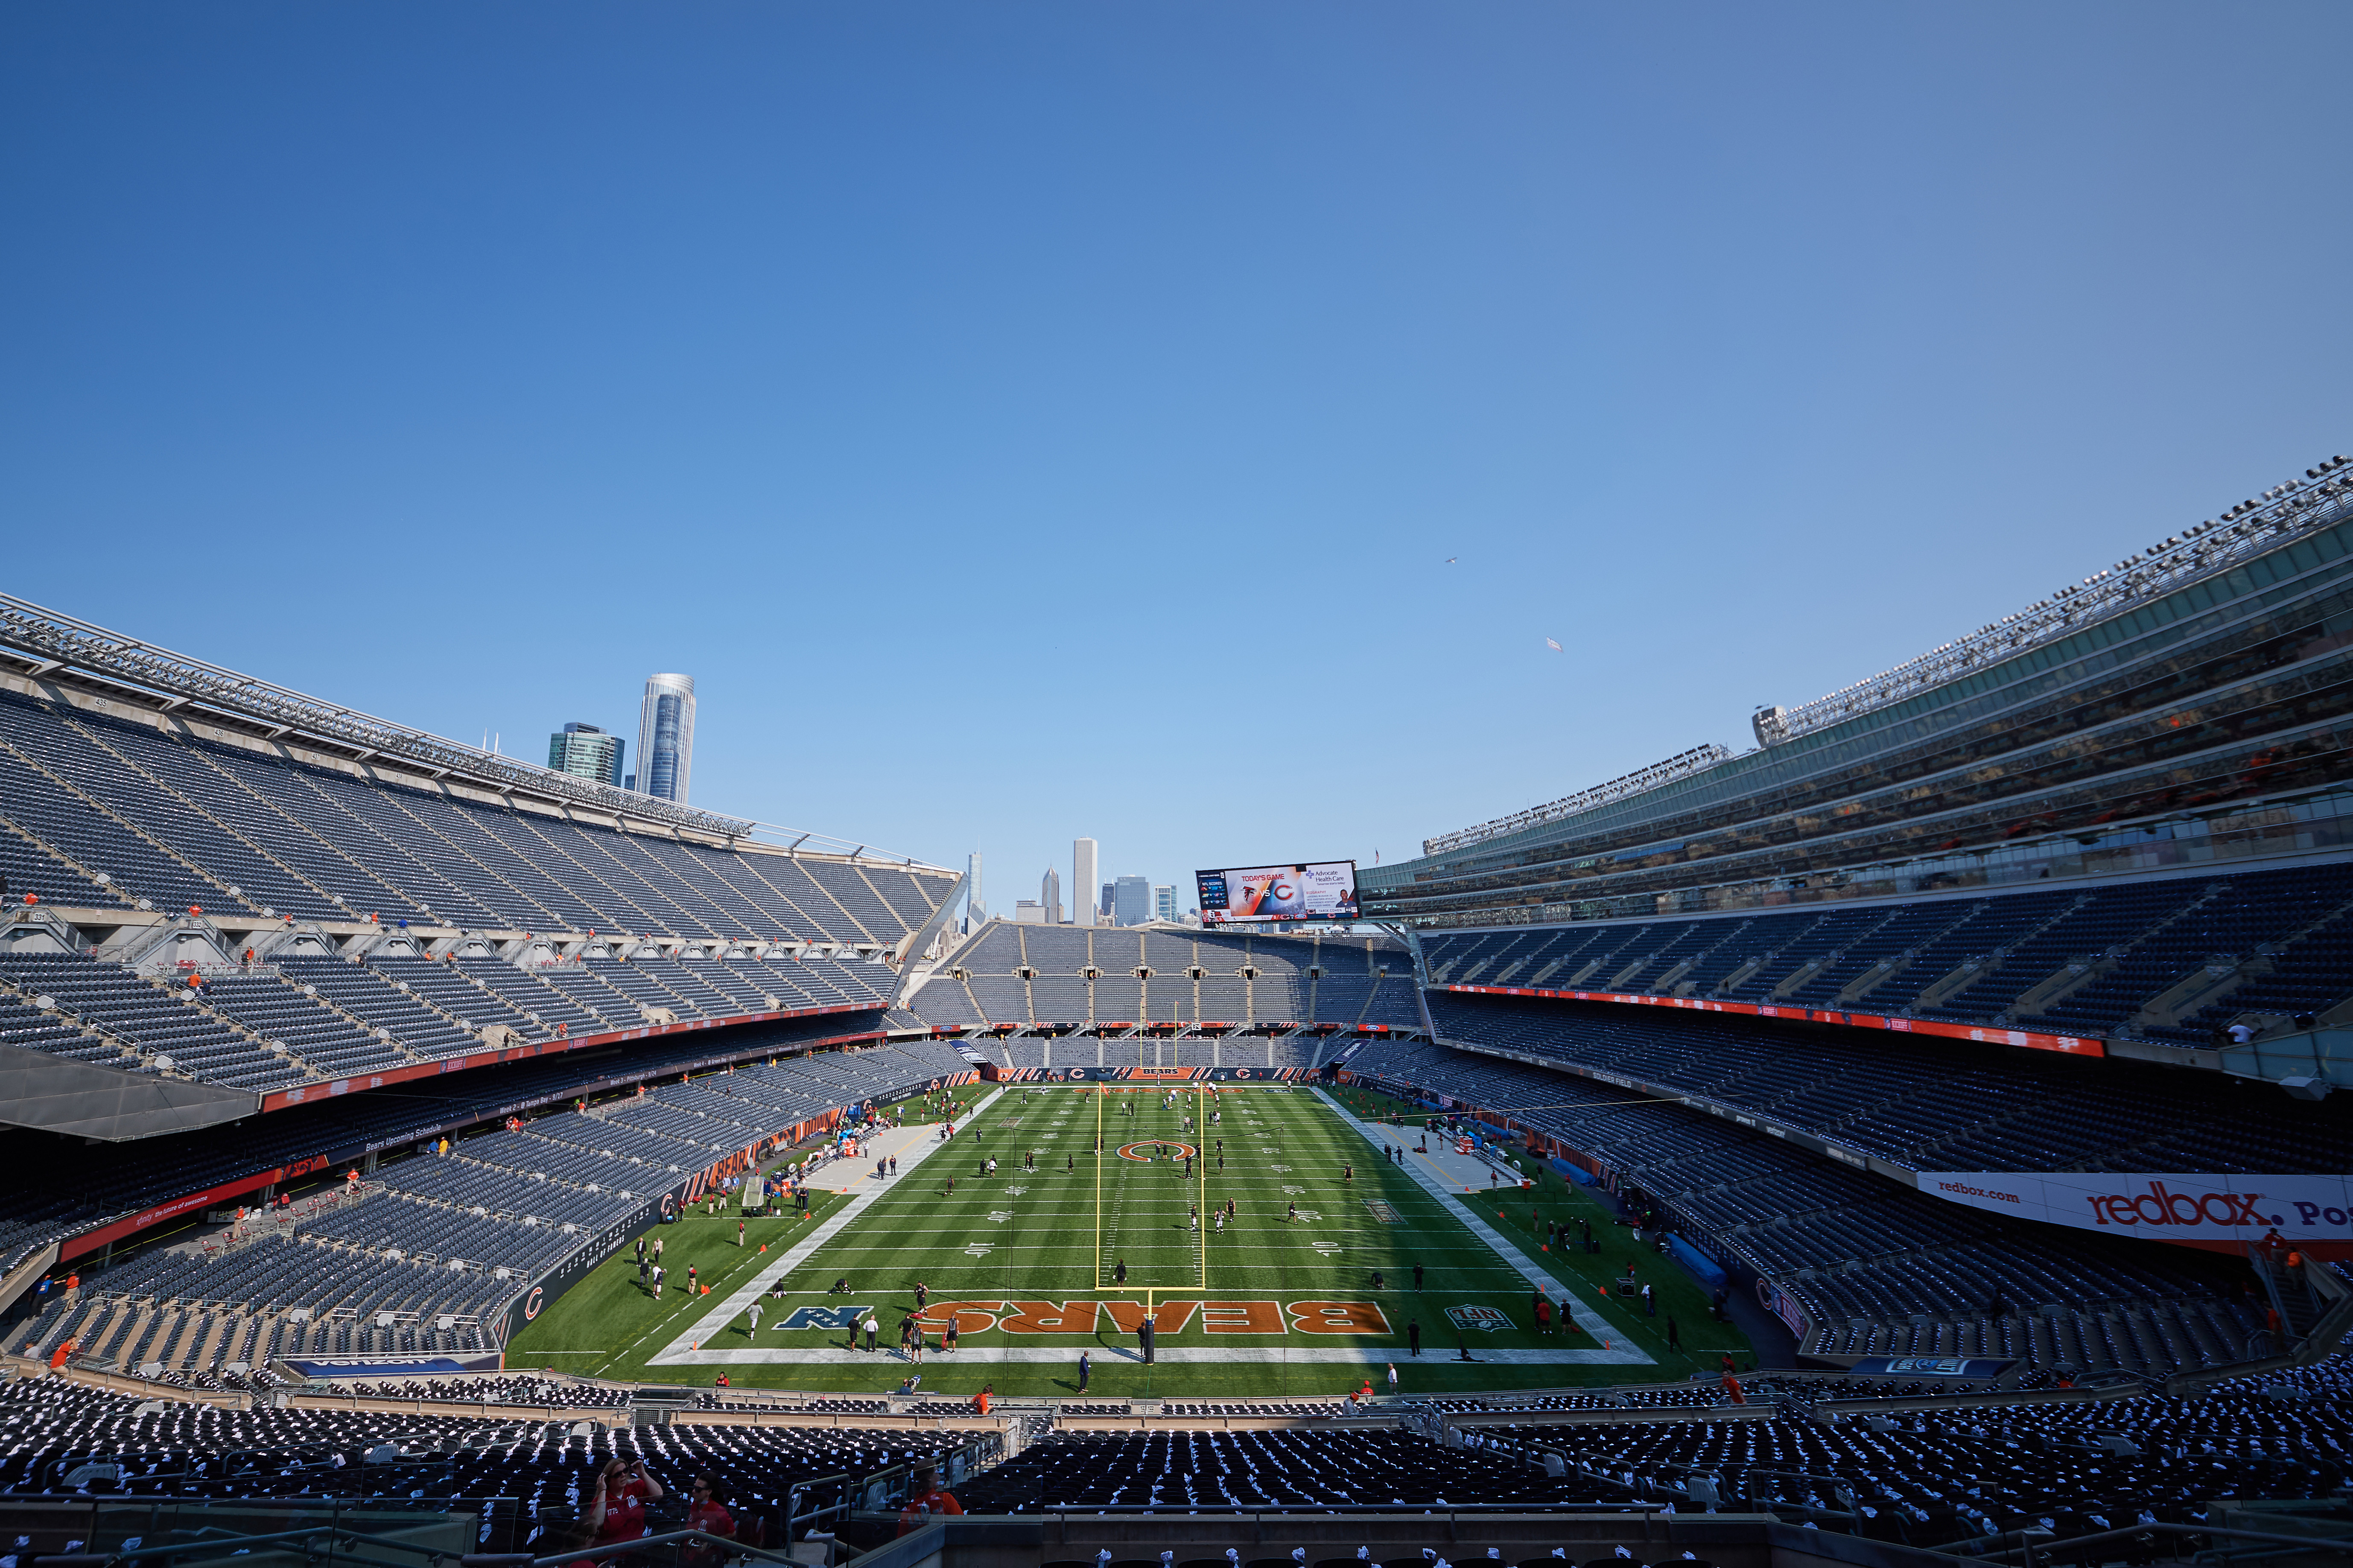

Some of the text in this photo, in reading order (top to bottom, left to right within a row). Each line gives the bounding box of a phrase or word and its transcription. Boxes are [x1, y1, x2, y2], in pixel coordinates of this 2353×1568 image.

[95, 698, 107, 707] 435
[215, 729, 223, 737] 436
[1891, 1019, 1908, 1029] KICKOFF
[447, 1060, 463, 1070] KICKOFF
[627, 1073, 645, 1081] Pittsburgh
[1593, 1072, 1631, 1088] SOLDIER FIELD
[500, 1105, 511, 1114] Week
[552, 1092, 563, 1100] 9/17
[366, 1124, 441, 1151] Bears Upcoming Schedule
[1766, 1125, 1784, 1138] verizon
[1282, 1186, 1306, 1195] 30
[1939, 1182, 2020, 1204] redbox.com
[136, 1213, 153, 1226] xfinity
[163, 1205, 177, 1214] future
[184, 1196, 207, 1207] awesome
[661, 1193, 673, 1214] C
[2087, 1181, 2272, 1226] redbox
[1293, 1211, 1322, 1223] 20
[587, 1235, 624, 1268] HALL OF FAMERS
[964, 1242, 995, 1259] 10
[1312, 1242, 1343, 1257] 10
[1756, 1278, 1772, 1310] C
[525, 1286, 543, 1320] C
[914, 1300, 1394, 1334] BEARS
[1453, 1309, 1501, 1319] NFL
[607, 1507, 618, 1516] 1775
